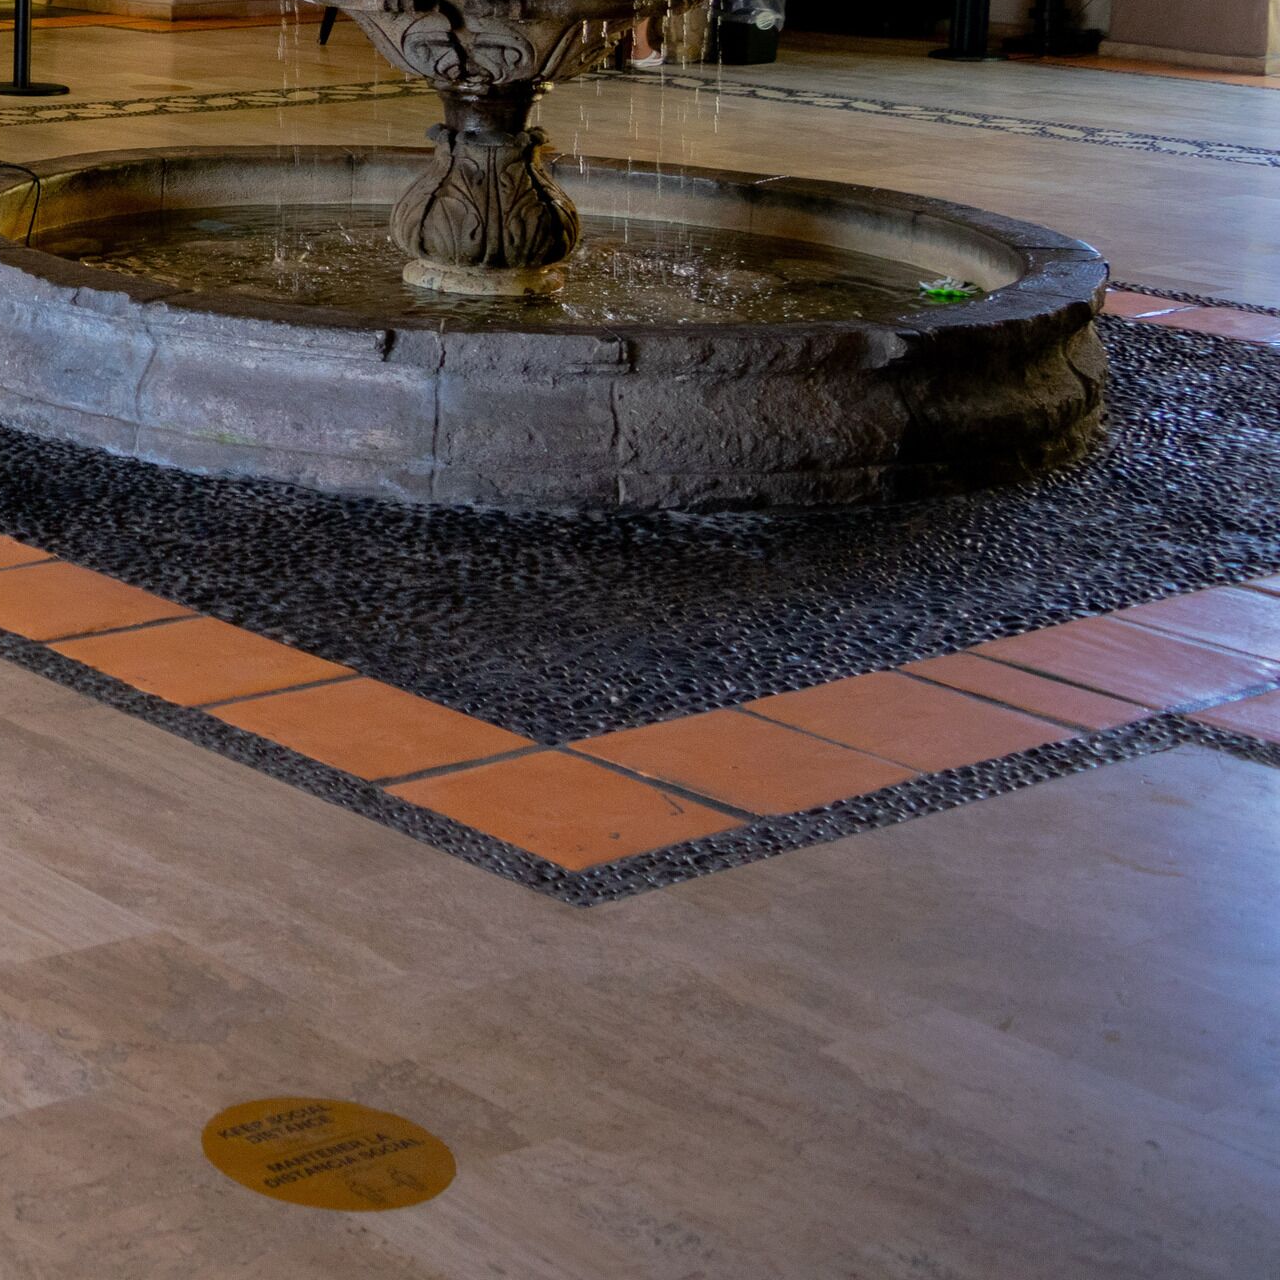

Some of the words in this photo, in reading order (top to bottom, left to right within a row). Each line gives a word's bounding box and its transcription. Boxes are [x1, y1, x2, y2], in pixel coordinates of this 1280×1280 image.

[265, 1103, 333, 1125] SOCIAL
[263, 1154, 357, 1189] DISTANCIA
[357, 1137, 426, 1160] SOCIAL
[266, 1139, 365, 1173] MANTENER
[360, 1131, 392, 1147] LA
